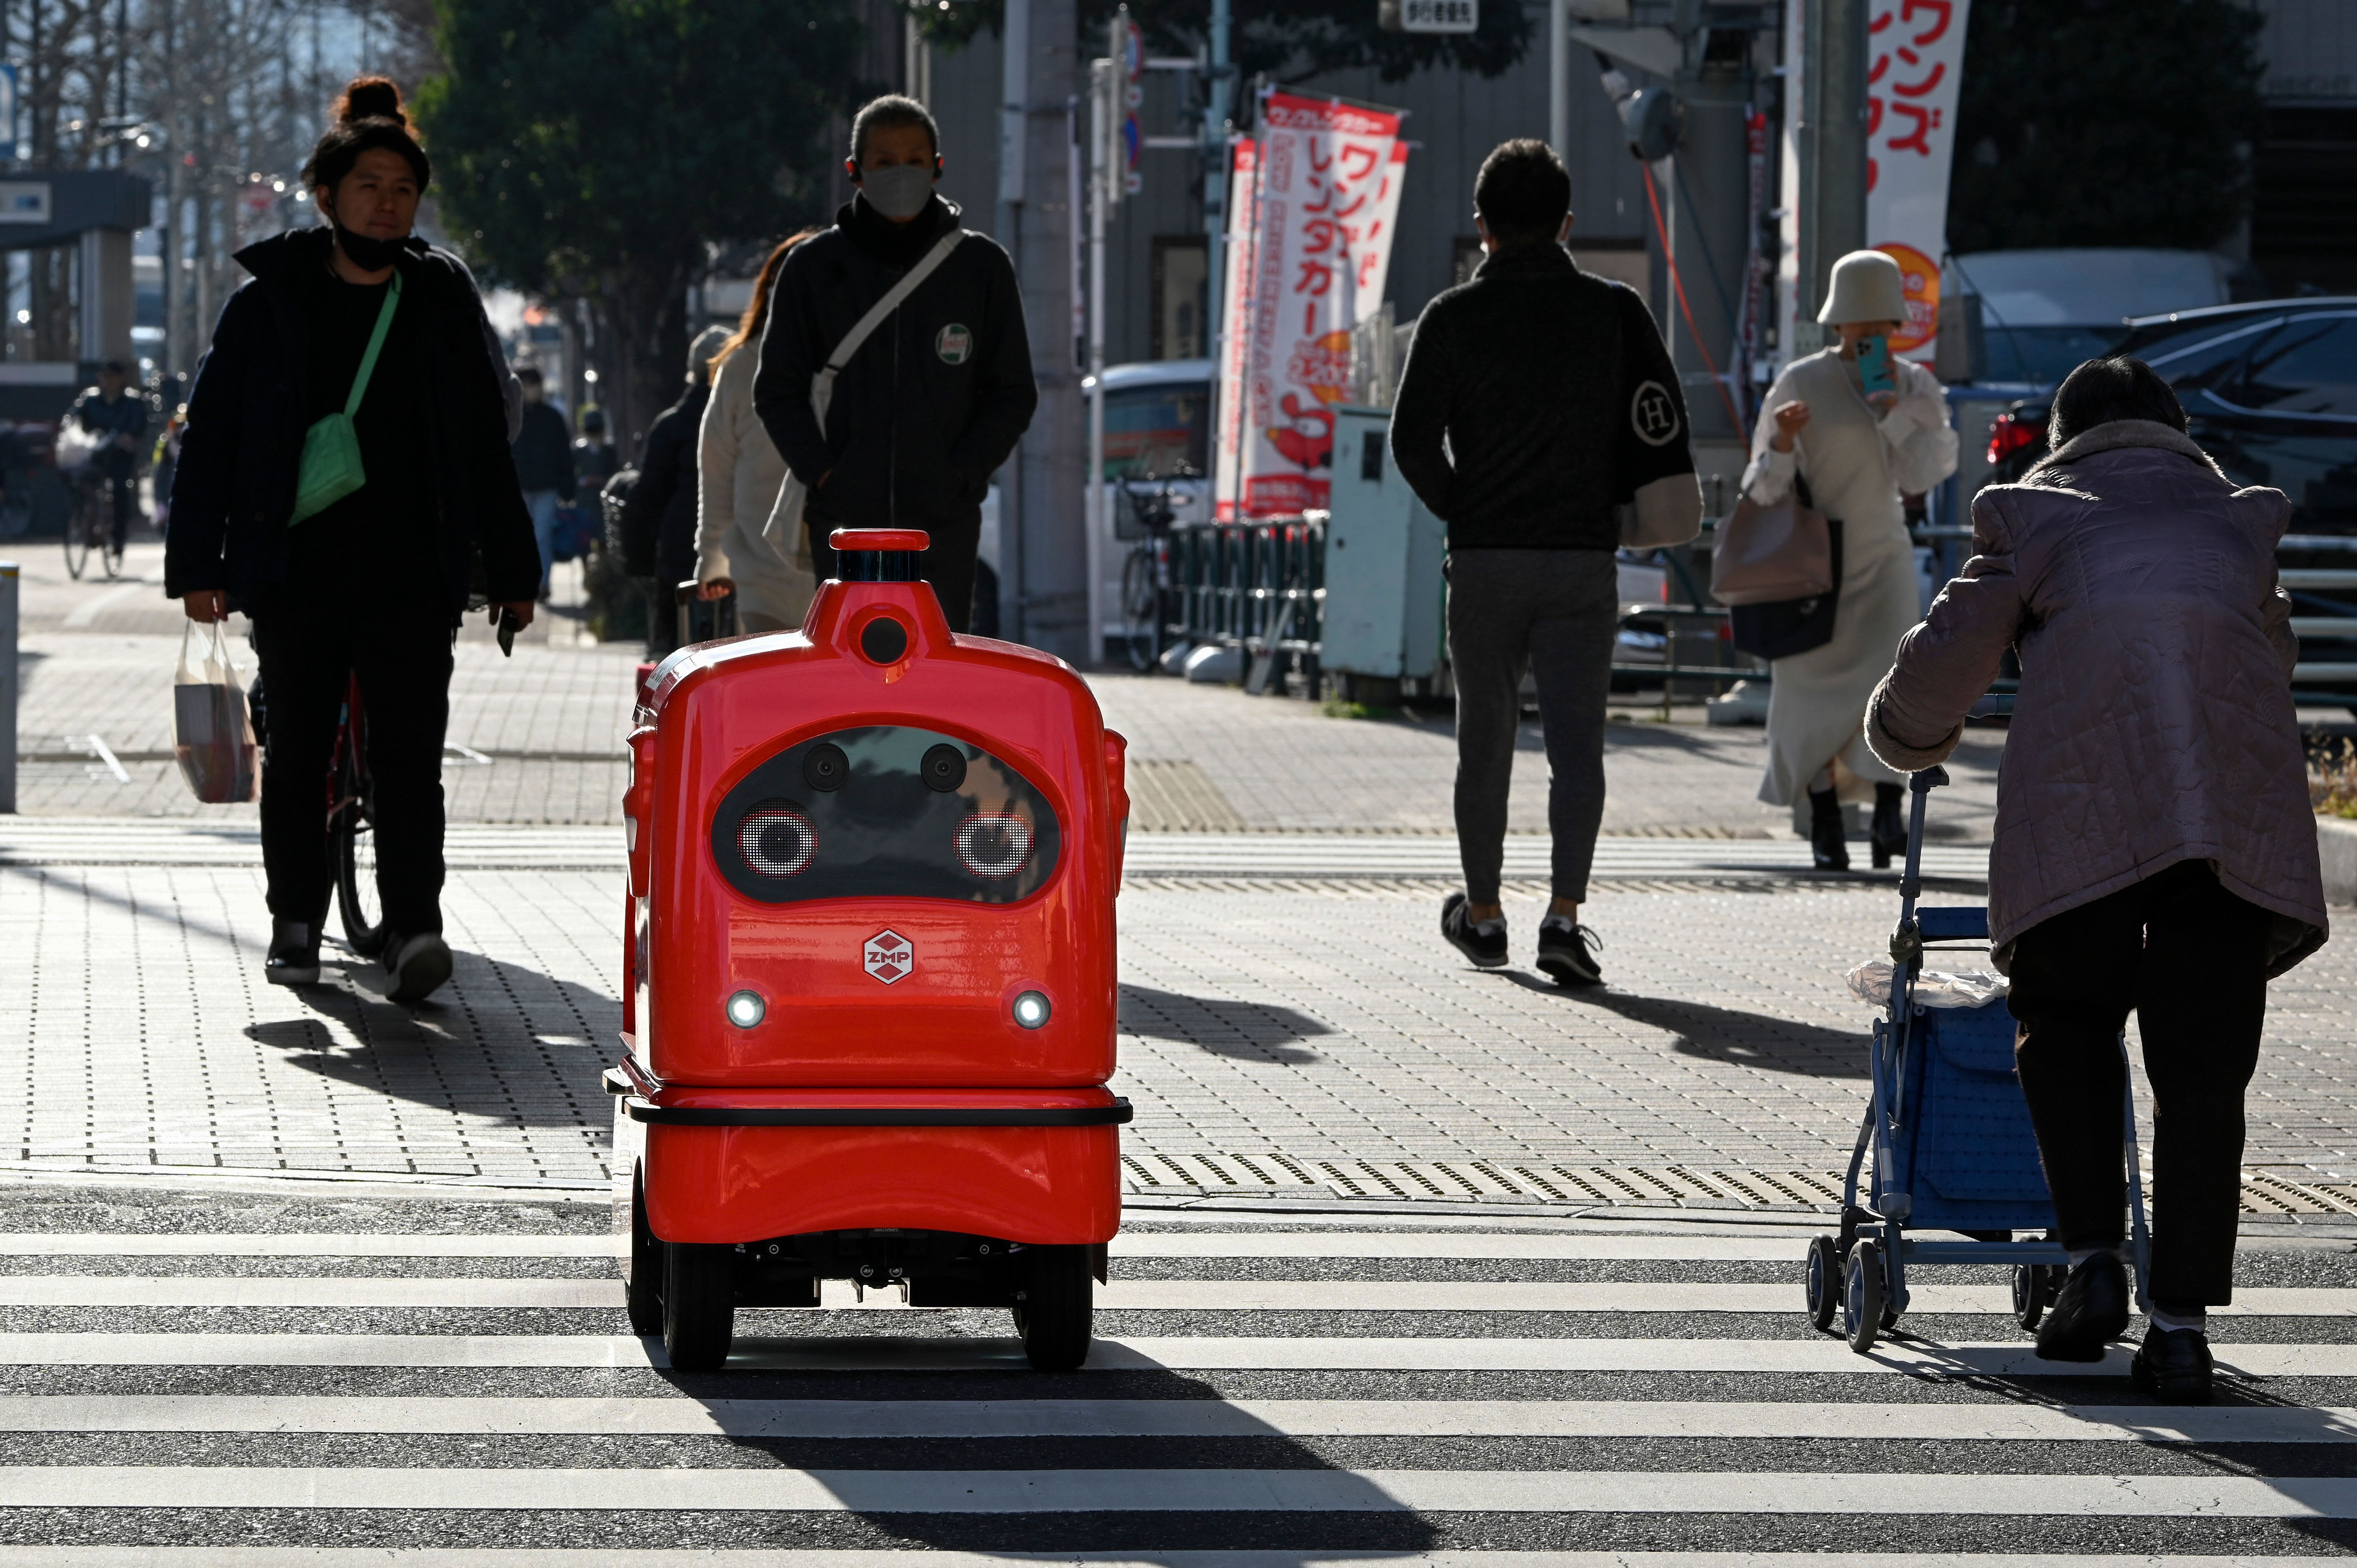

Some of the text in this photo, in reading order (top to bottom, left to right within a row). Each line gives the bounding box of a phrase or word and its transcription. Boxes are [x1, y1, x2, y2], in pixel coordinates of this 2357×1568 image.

[1887, 0, 1952, 157] ワンズ
[1293, 135, 1334, 337] レンタカー
[1641, 396, 1670, 432] H
[868, 952, 910, 963] ZMP
